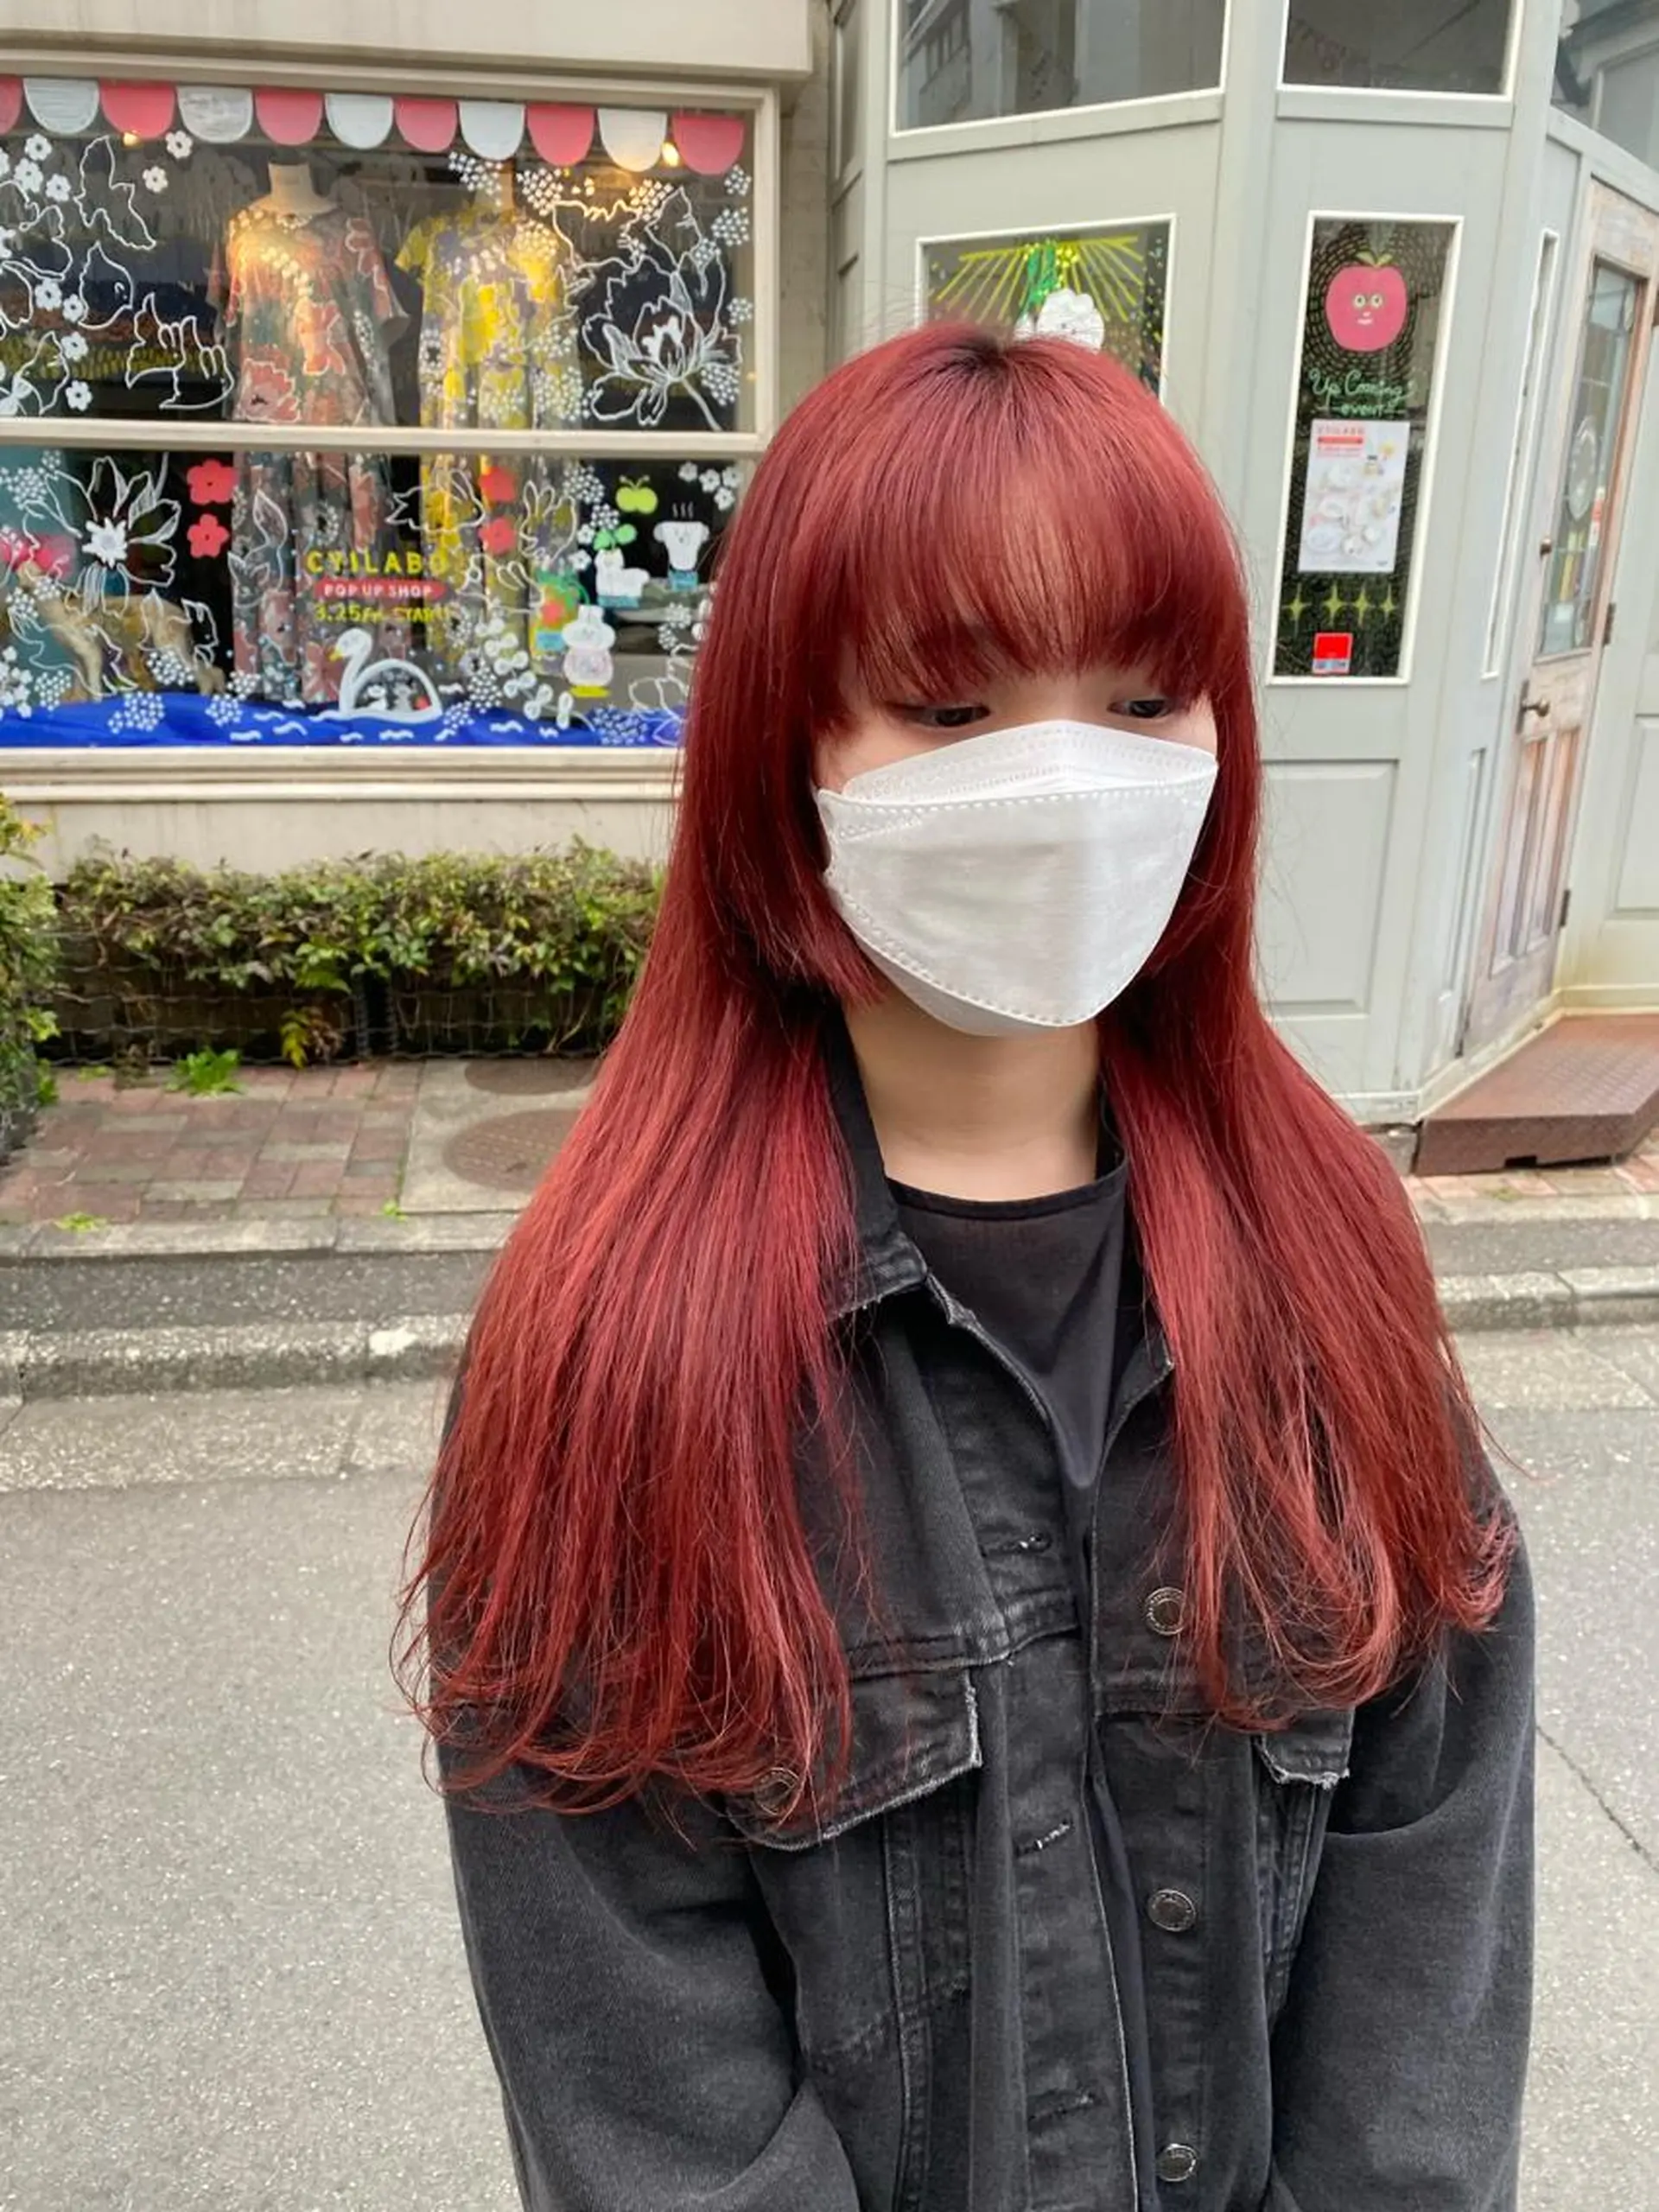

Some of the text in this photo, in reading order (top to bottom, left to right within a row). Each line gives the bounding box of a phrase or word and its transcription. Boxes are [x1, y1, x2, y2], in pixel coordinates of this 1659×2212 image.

[324, 583, 432, 598] POP UP SHOP
